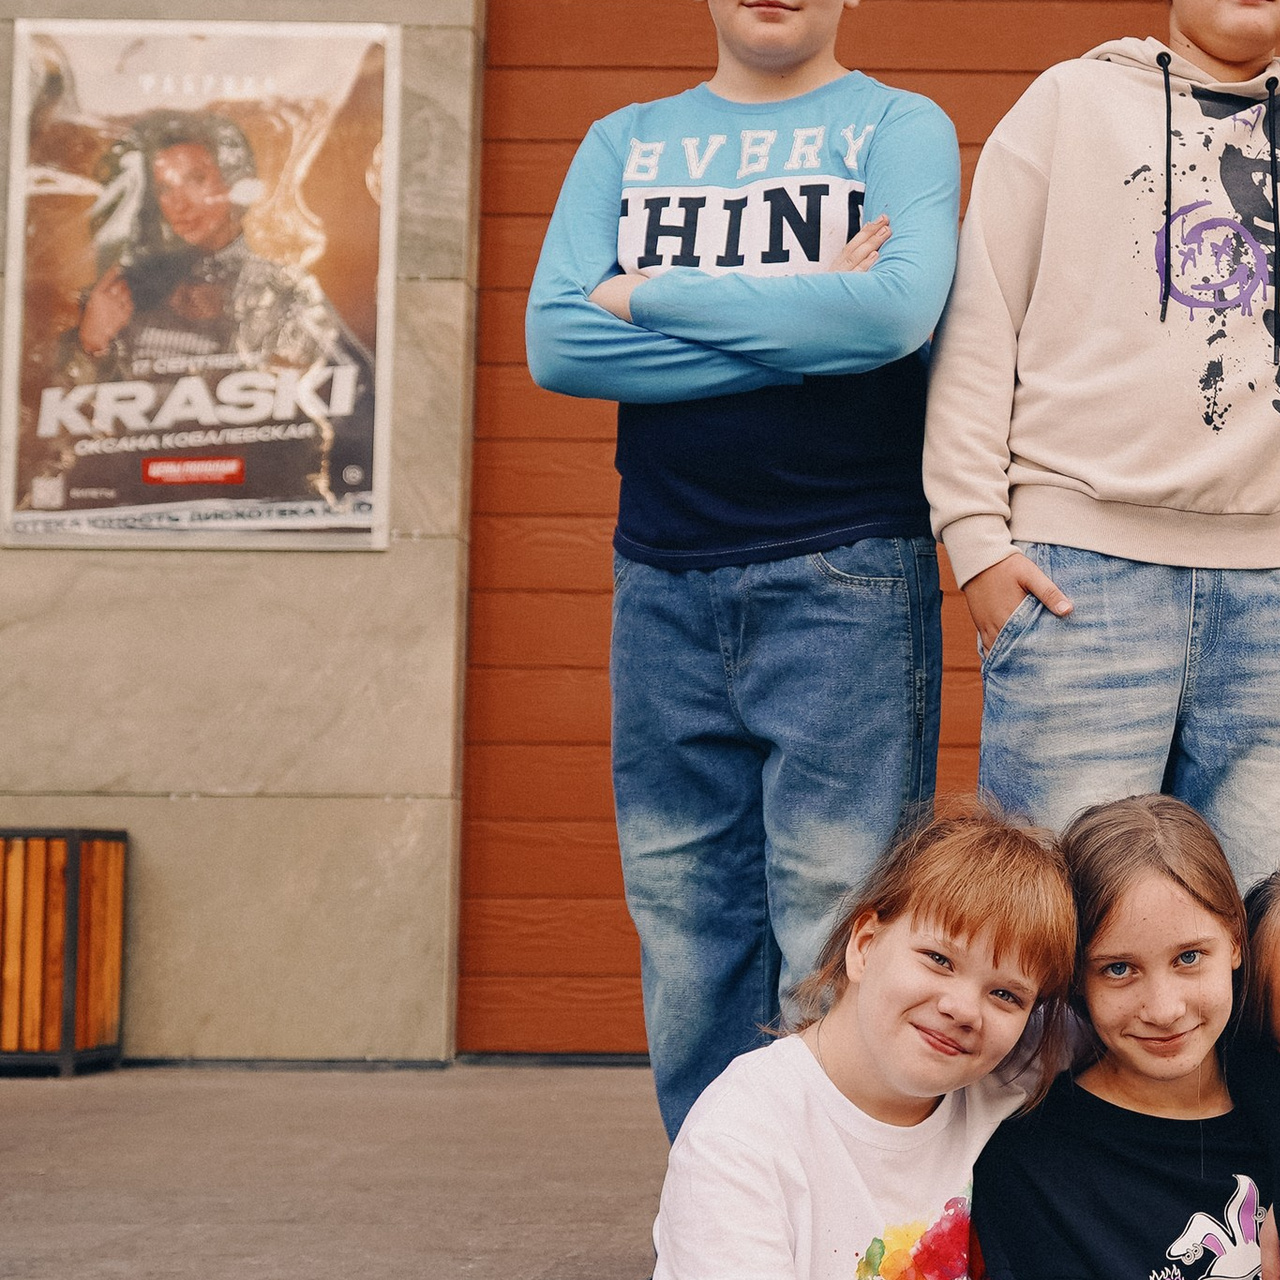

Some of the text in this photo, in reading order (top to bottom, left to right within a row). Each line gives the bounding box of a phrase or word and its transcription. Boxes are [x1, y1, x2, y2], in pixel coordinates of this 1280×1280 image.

[622, 123, 876, 182] EVERY
[619, 183, 866, 270] HIN
[36, 364, 358, 439] KRASKI
